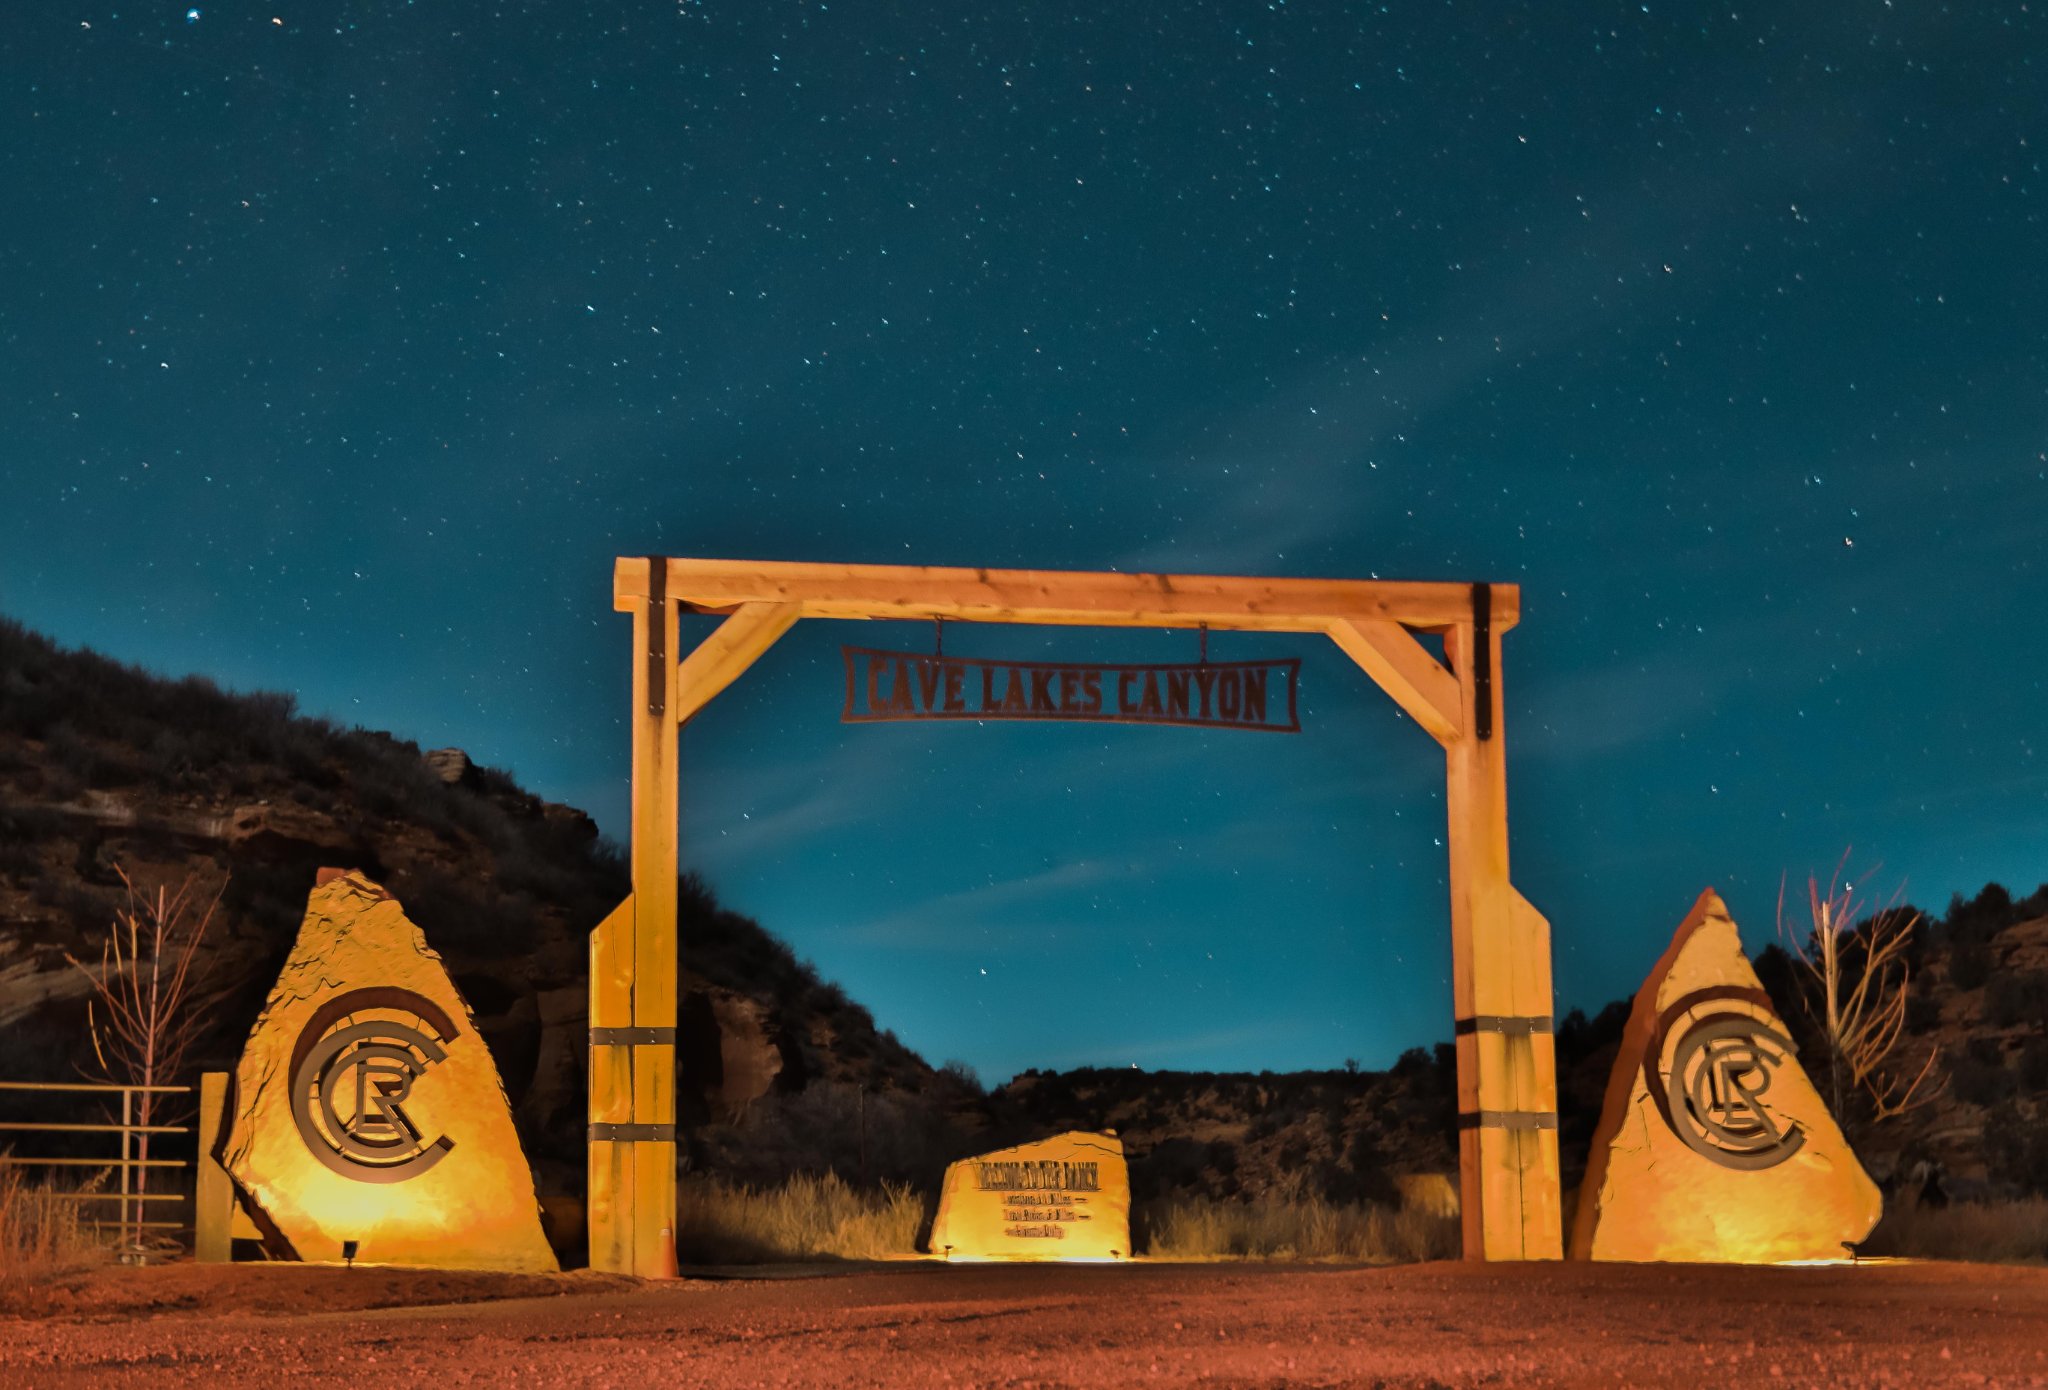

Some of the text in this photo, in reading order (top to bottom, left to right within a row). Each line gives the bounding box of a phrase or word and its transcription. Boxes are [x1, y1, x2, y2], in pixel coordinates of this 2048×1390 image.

[867, 657, 1267, 722] CAVE LAKES CANYON
